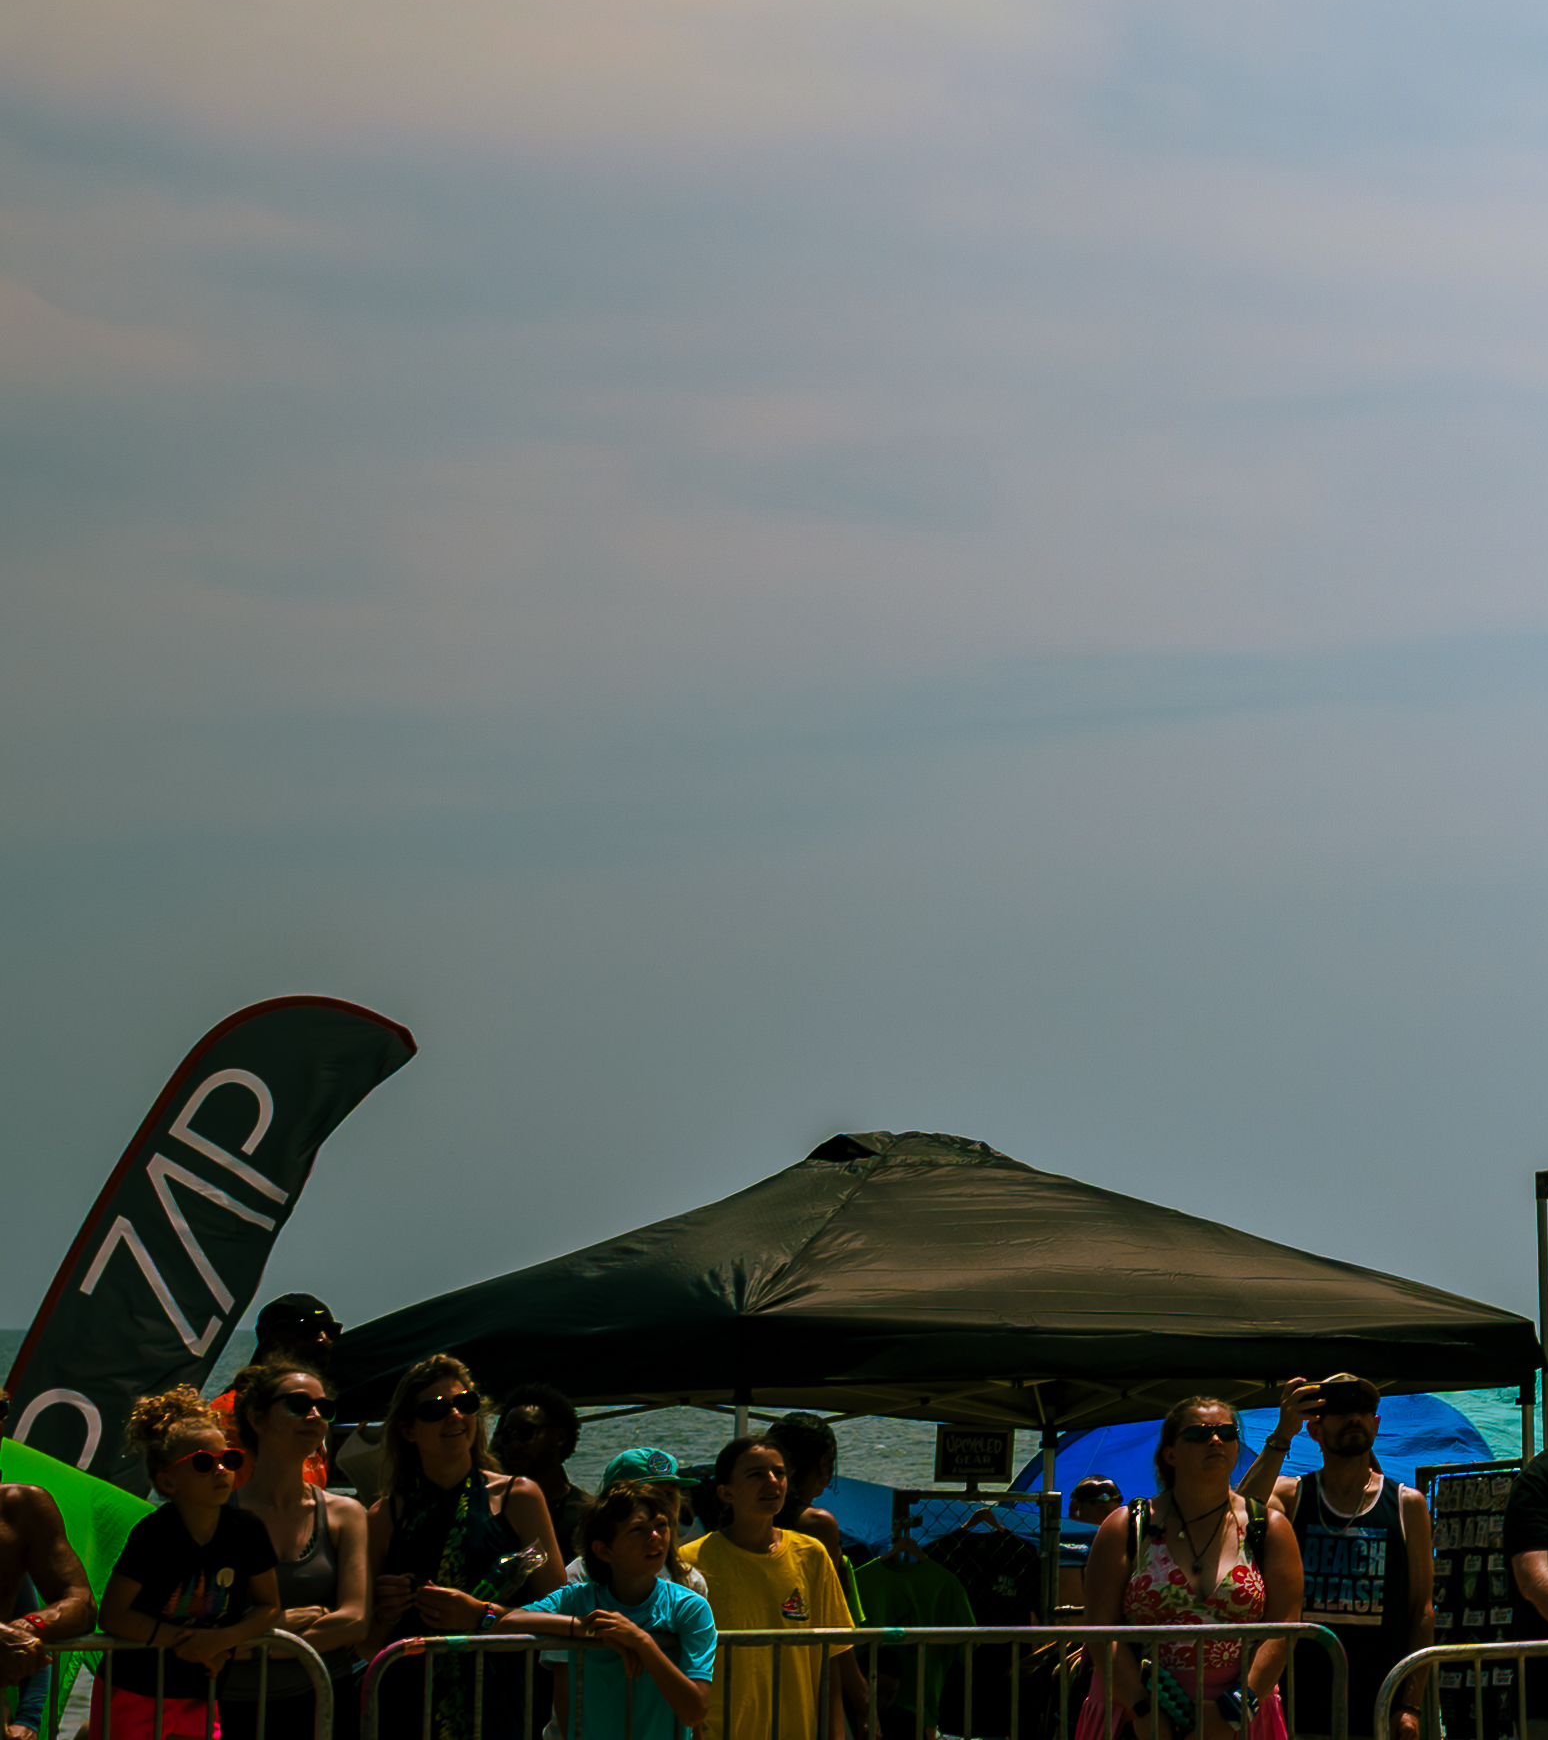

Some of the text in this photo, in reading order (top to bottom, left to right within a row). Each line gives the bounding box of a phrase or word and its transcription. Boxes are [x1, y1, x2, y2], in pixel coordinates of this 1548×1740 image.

[79, 1068, 289, 1357] ZAP
[946, 1433, 1003, 1454] UPCYCLED
[954, 1454, 992, 1465] GEAR
[1303, 1536, 1388, 1576] BEACH
[1303, 1575, 1385, 1613] PLEASE
